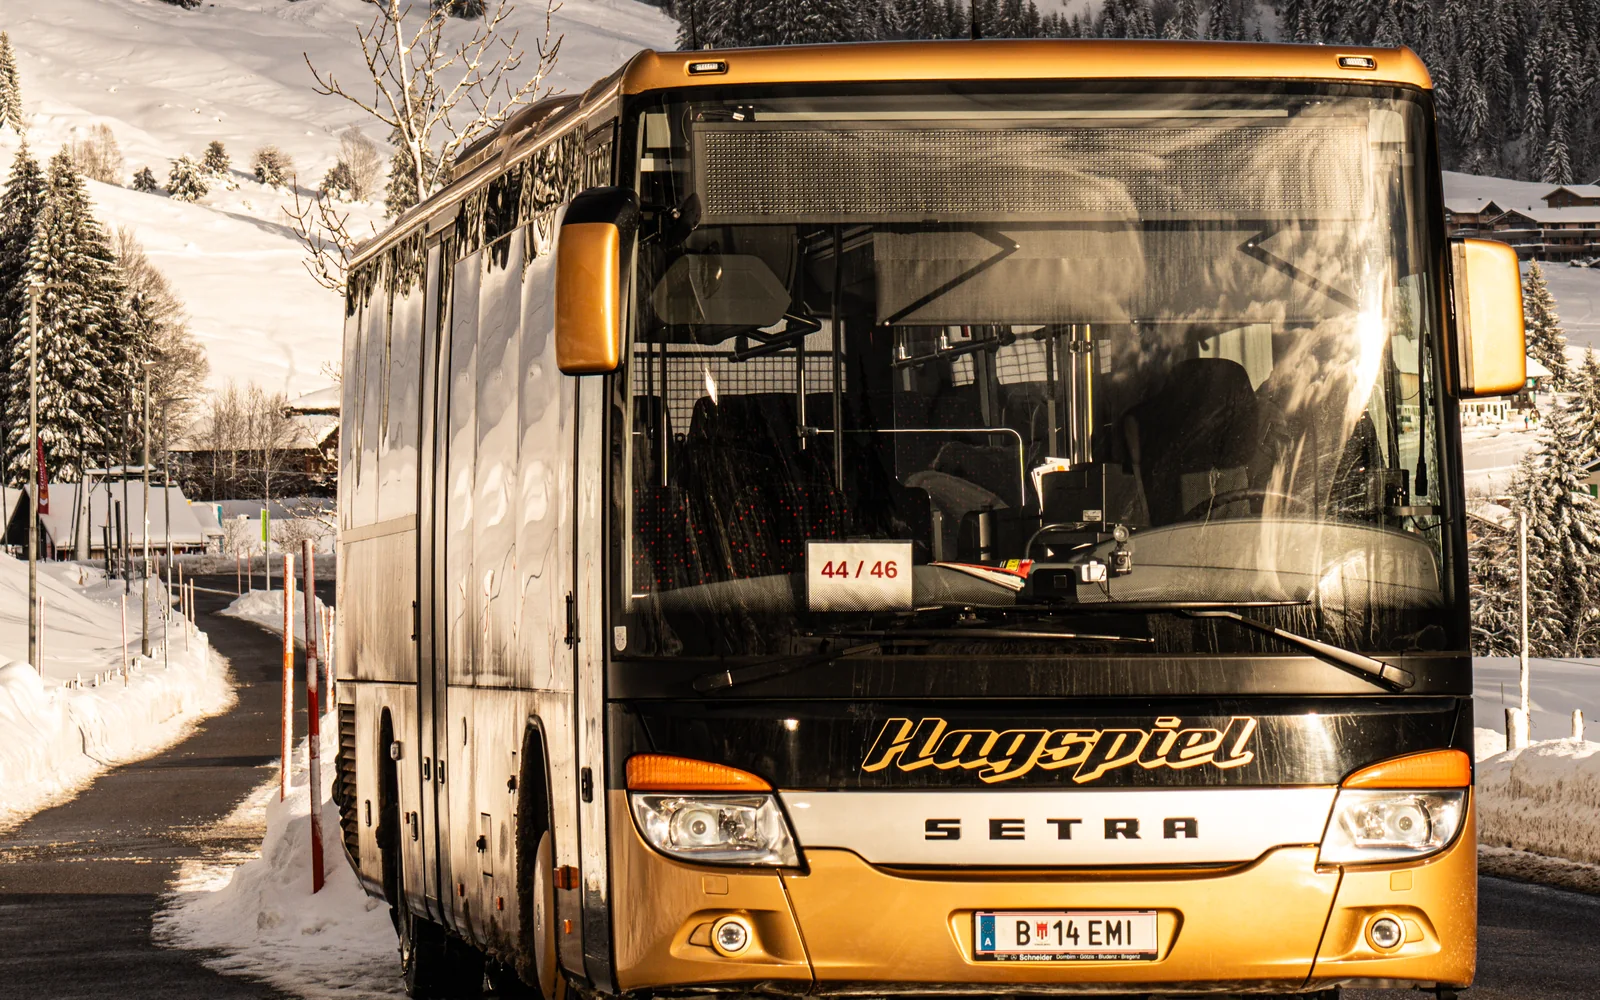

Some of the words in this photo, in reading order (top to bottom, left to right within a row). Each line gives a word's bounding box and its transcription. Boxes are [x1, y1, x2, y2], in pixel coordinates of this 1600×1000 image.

[821, 561, 849, 579] 44
[870, 561, 898, 579] 46
[862, 716, 1257, 784] Hagspiel
[925, 818, 1199, 840] SETRA
[984, 937, 992, 946] A
[1016, 920, 1031, 946] B
[1053, 920, 1080, 946] 14
[1088, 920, 1132, 946] EMI
[1019, 953, 1053, 961] Schneider
